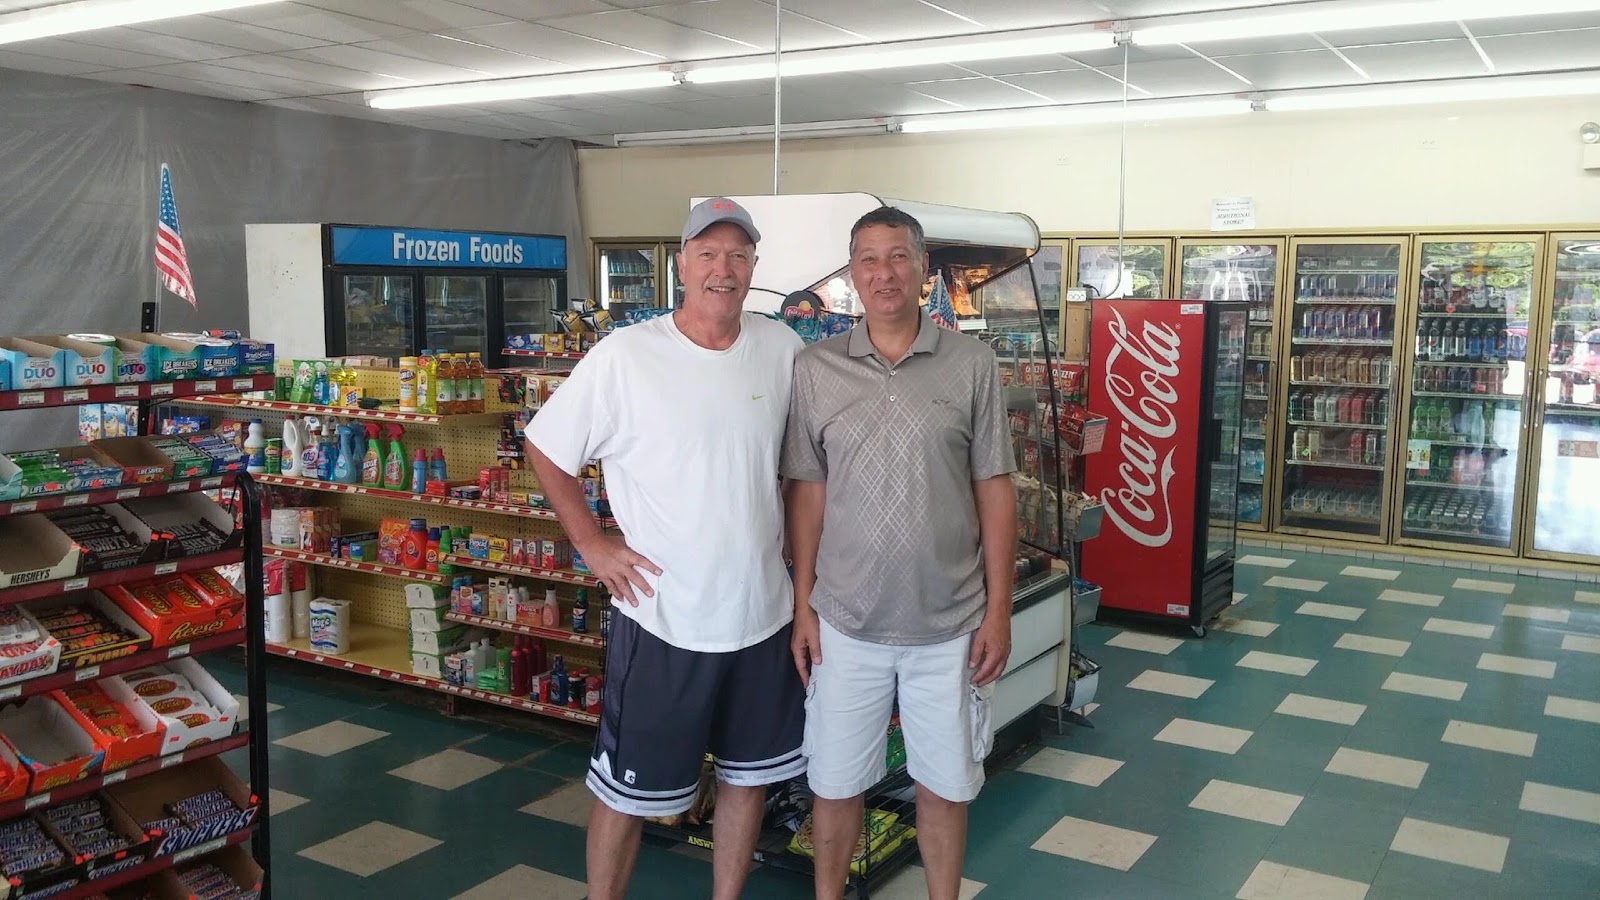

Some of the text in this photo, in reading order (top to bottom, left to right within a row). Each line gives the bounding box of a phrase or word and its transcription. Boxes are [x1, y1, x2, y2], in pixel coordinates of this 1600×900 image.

[393, 232, 524, 264] Frozen Foods
[24, 367, 56, 380] DUO
[76, 363, 106, 376] DUO
[117, 363, 147, 377] DUO
[10, 569, 50, 584] HERSHEY'S
[155, 806, 258, 857] SNICKERS
